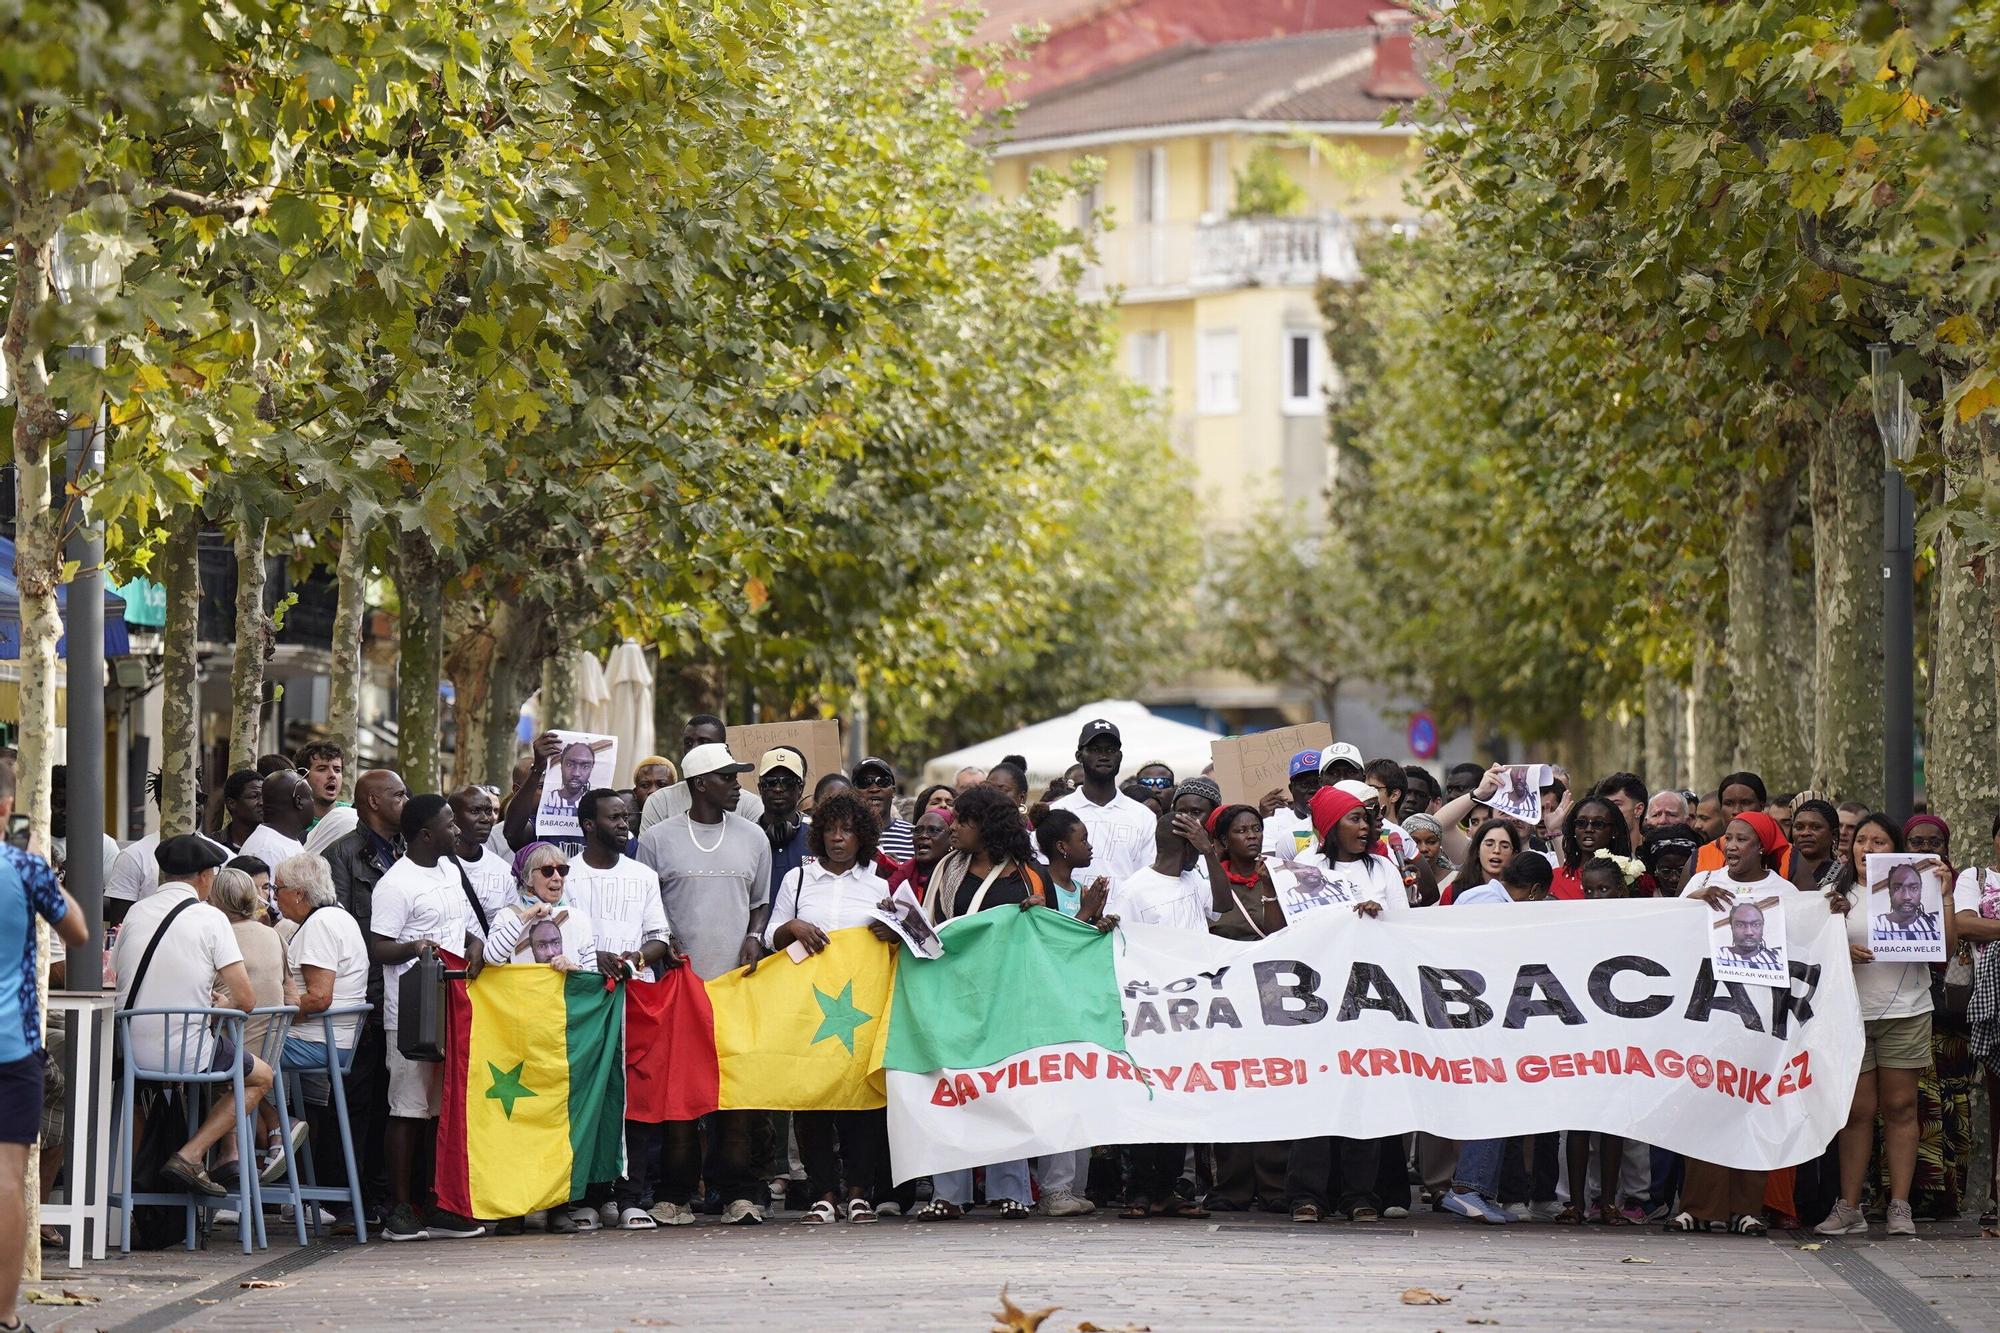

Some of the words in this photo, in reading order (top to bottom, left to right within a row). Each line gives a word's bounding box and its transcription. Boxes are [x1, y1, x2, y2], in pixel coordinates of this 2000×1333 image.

[1302, 753, 1318, 766] C
[539, 819, 575, 828] BABACAR
[1873, 945, 1912, 953] BABACAR
[1914, 945, 1941, 953] WELER
[1718, 969, 1756, 978] BABACAR
[1758, 973, 1785, 981] WELER
[1252, 955, 1822, 1041] BABACAR
[1121, 997, 1243, 1037] ARA
[930, 1051, 1099, 1107] BAYILEN
[1338, 1048, 1507, 1084] KRIMEN
[1776, 1050, 1813, 1097] EZ
